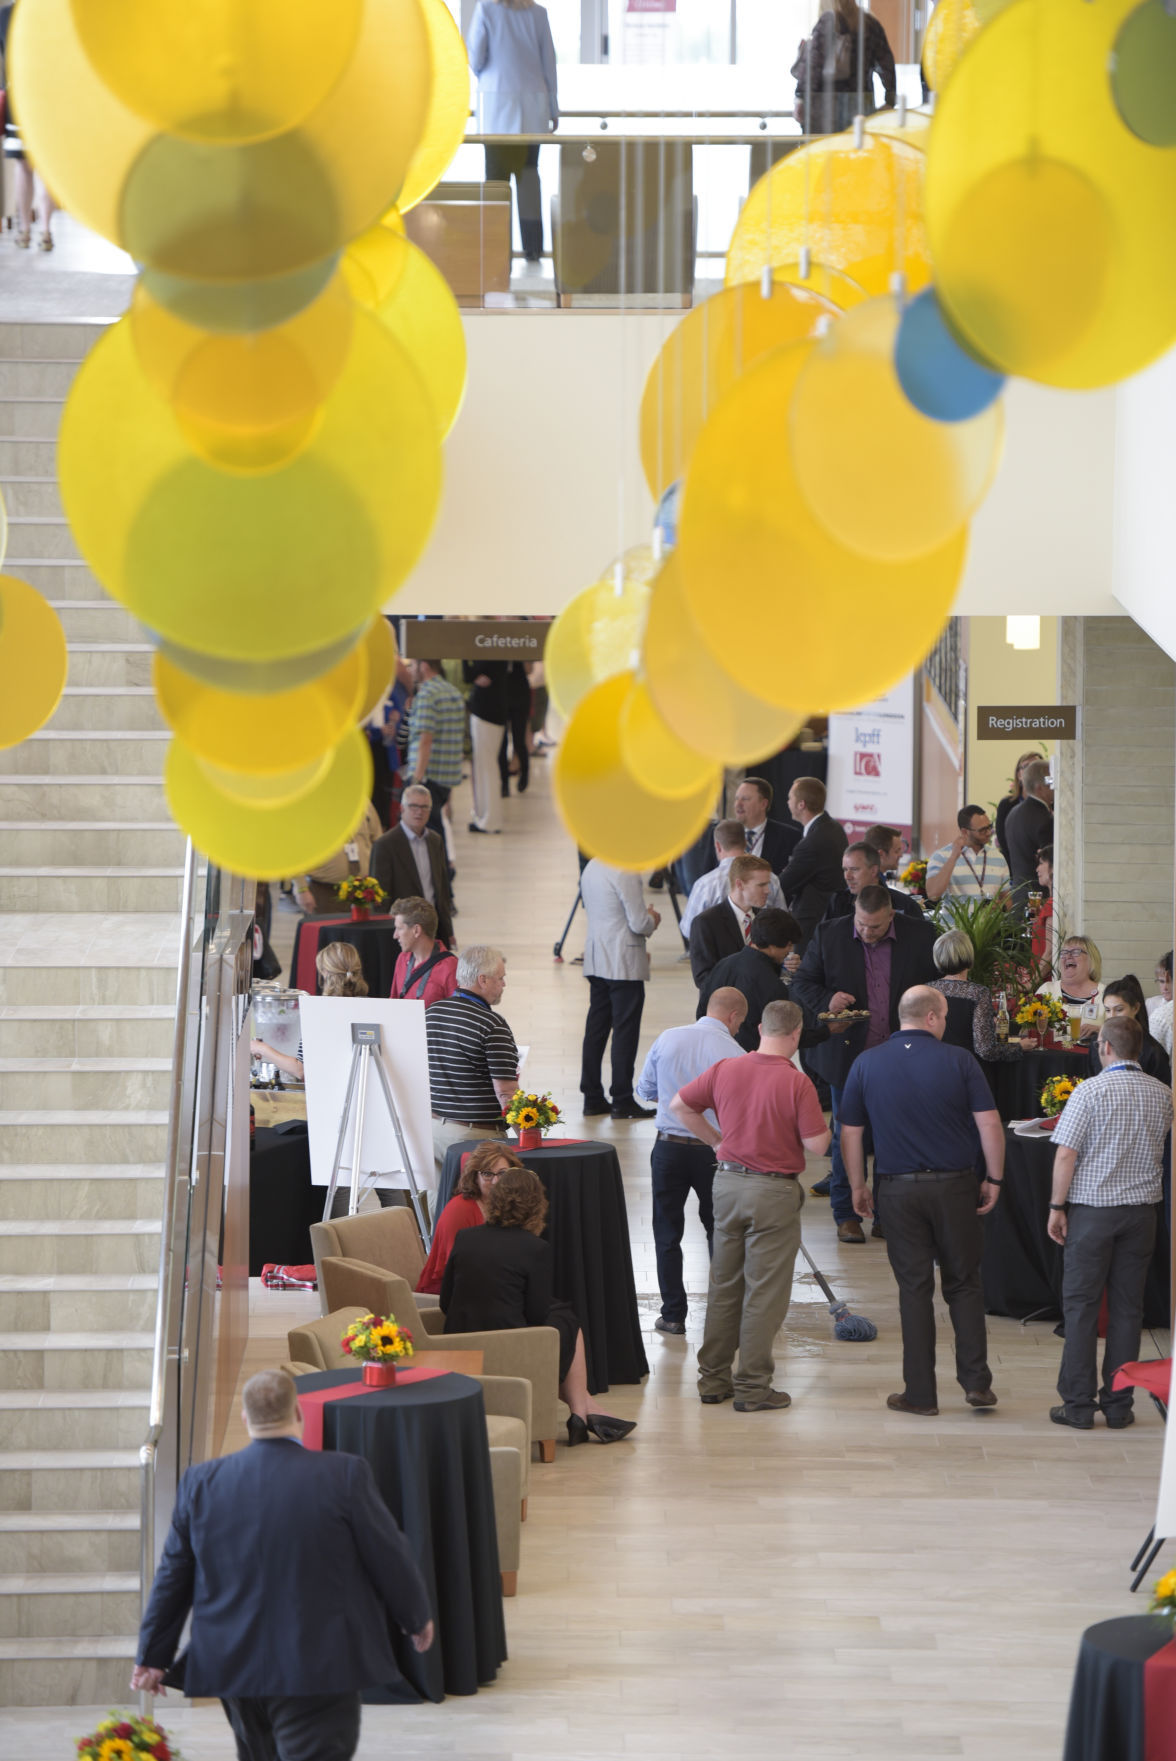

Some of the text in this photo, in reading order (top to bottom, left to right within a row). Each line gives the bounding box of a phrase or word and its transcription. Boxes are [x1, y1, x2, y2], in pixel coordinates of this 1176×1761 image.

[474, 634, 538, 648] Cafeteria
[988, 715, 1066, 732] Registration
[855, 727, 882, 748] kpff
